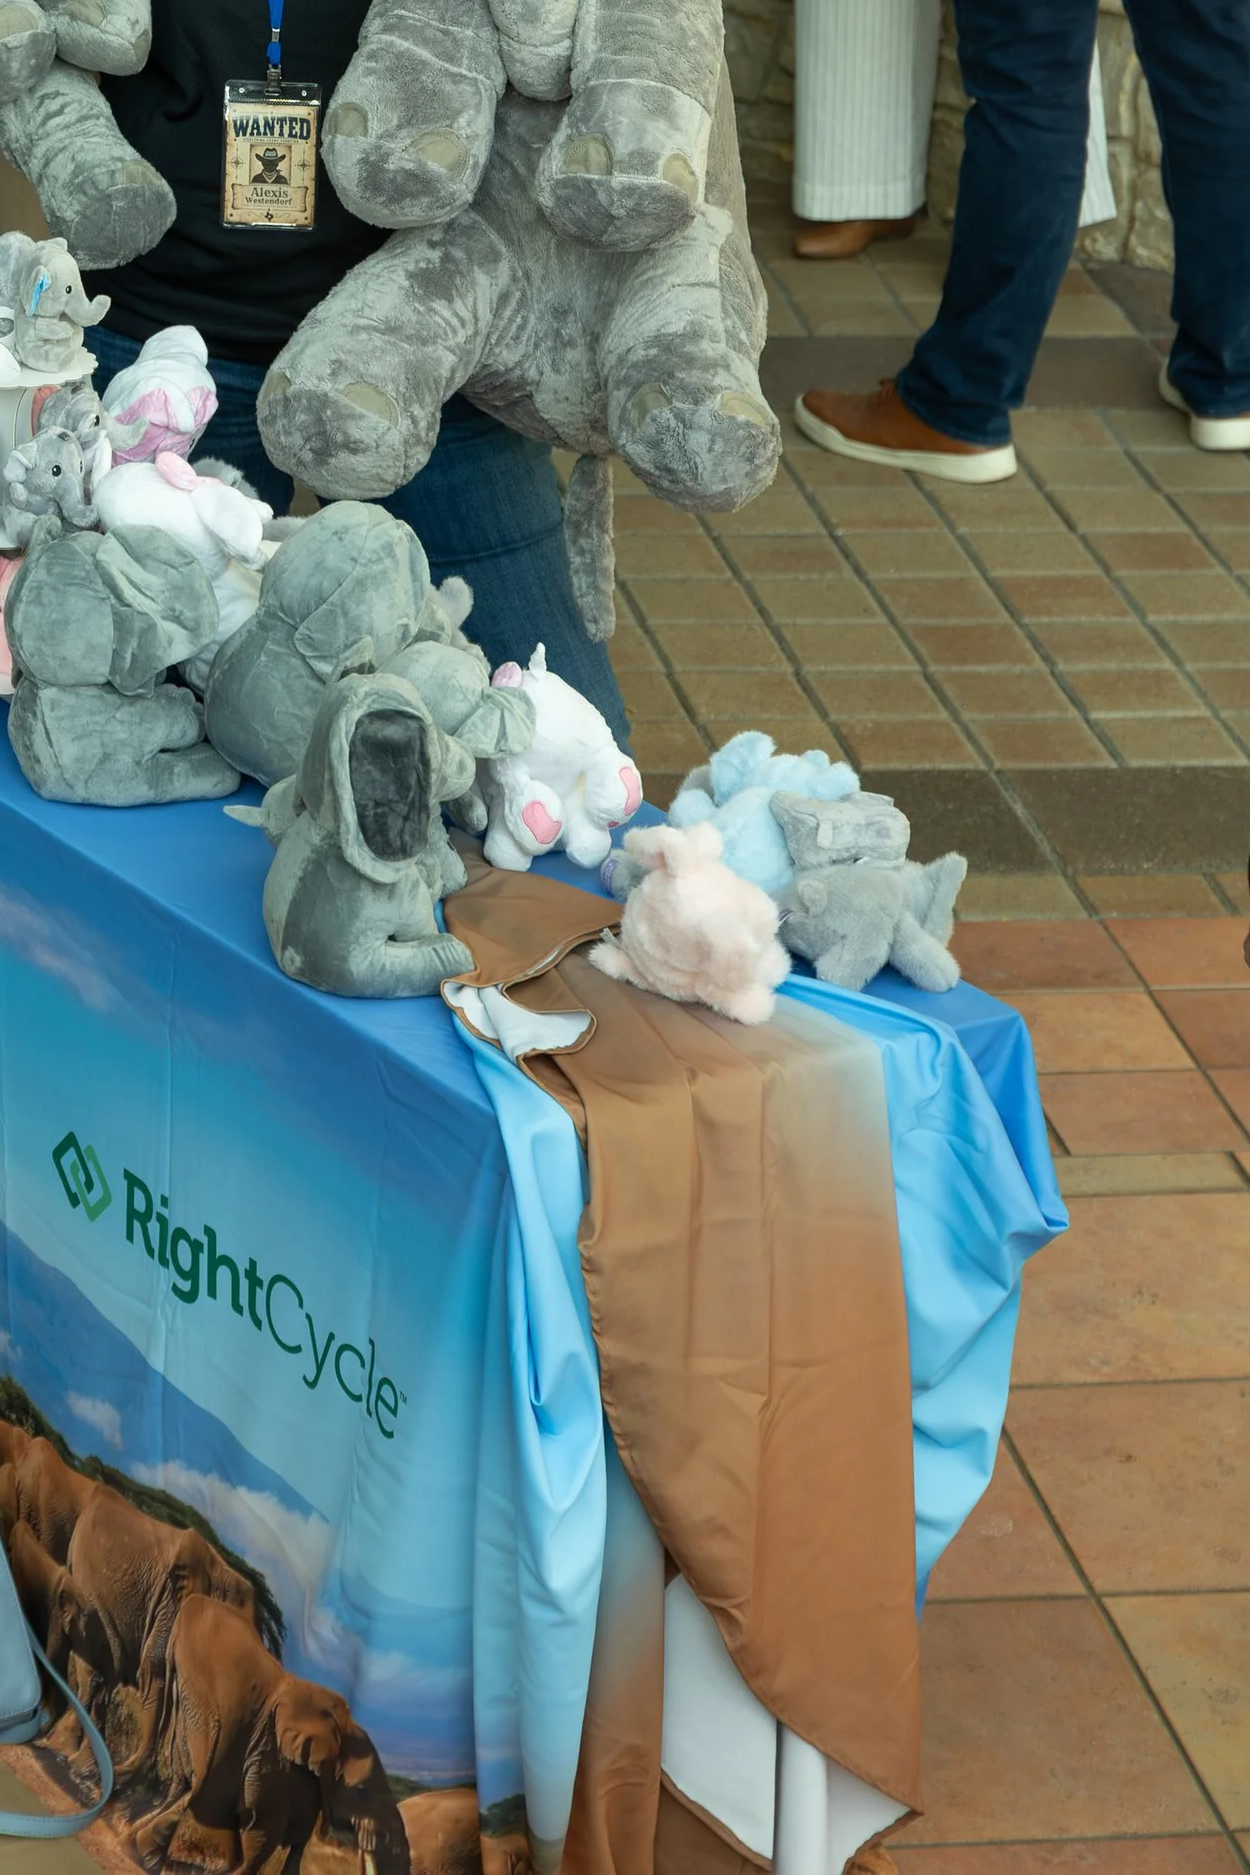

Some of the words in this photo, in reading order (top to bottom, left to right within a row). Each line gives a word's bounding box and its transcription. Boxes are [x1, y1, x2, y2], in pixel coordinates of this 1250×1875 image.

[232, 115, 311, 141] WANTED
[251, 187, 289, 199] Alexis
[245, 197, 293, 206] Westendorf
